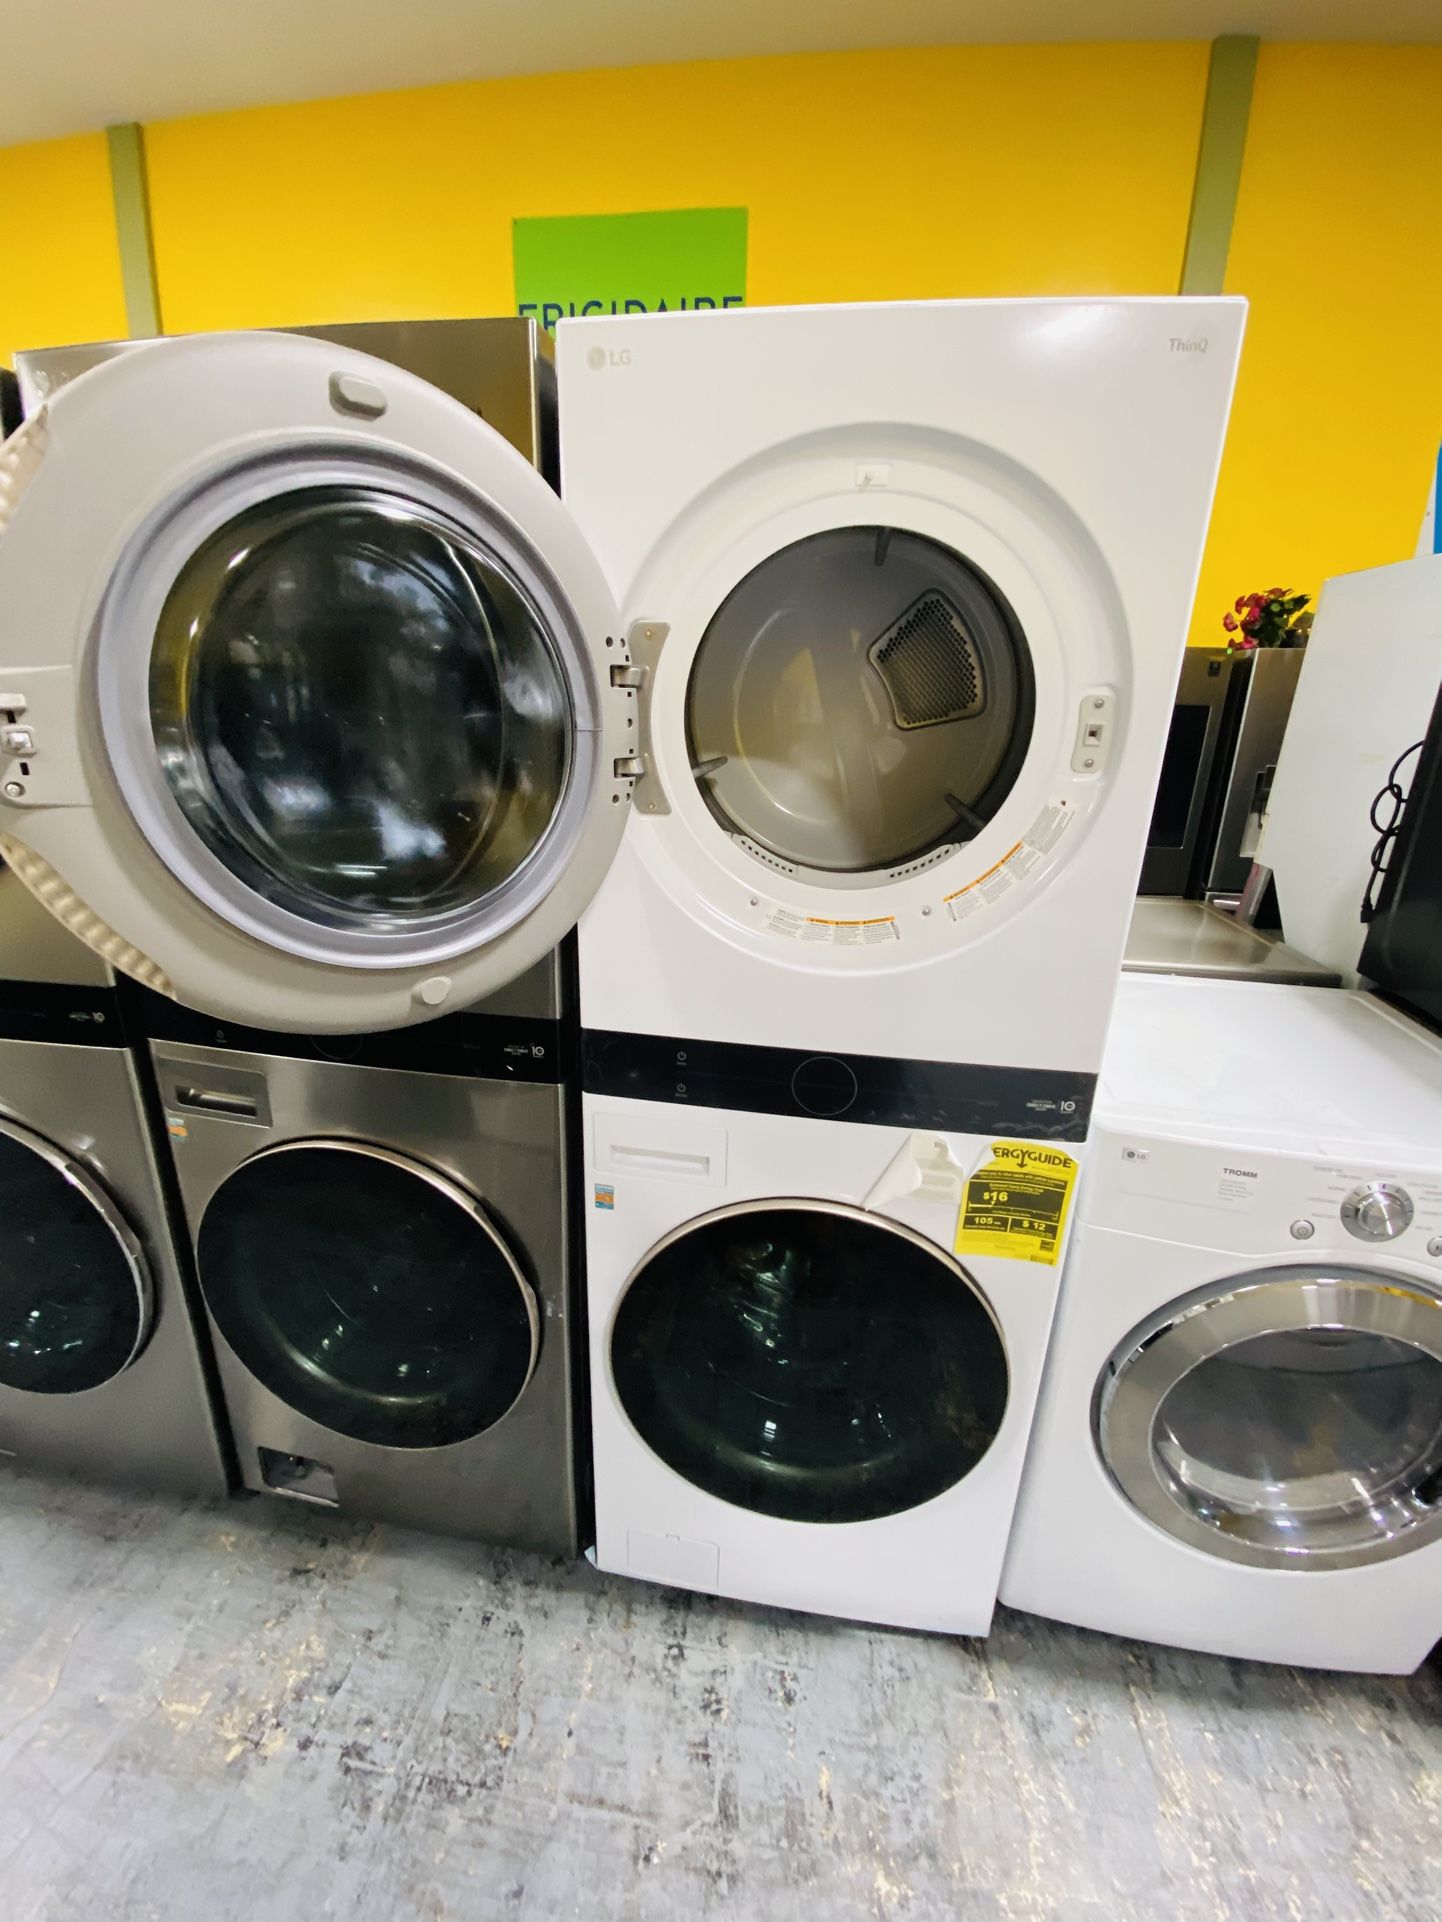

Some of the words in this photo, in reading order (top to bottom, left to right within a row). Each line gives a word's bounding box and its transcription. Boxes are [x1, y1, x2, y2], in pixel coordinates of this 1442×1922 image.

[1168, 337, 1209, 354] ThinQ
[610, 349, 631, 366] LG
[1223, 1167, 1258, 1179] TROMM
[983, 1191, 1009, 1202] $16
[974, 1217, 993, 1225] 105
[1033, 1222, 1046, 1231] 12
